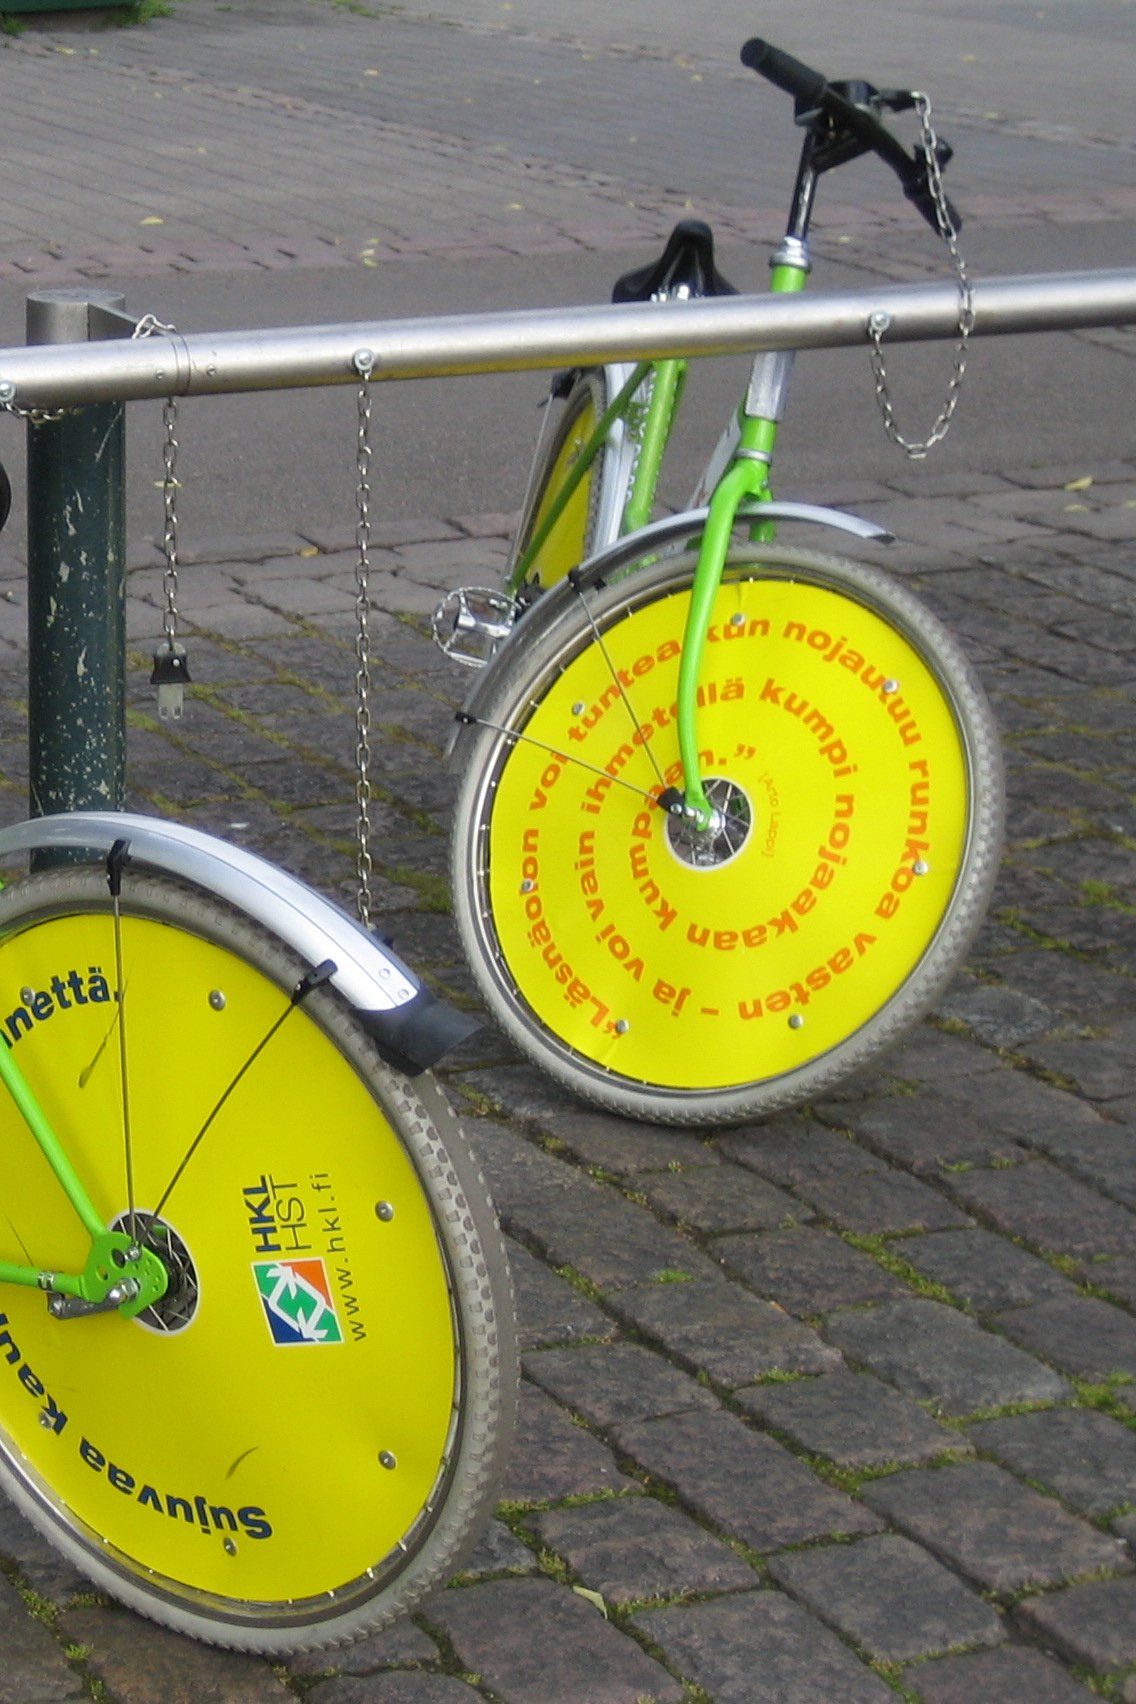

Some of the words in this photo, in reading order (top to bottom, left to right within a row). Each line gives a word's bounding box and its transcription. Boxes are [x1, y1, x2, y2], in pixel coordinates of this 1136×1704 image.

[568, 639, 681, 744] tuntea
[760, 678, 859, 779] kumpi
[574, 830, 605, 922] vain
[686, 793, 855, 952] nojaakaan
[875, 759, 930, 921] runkoa
[596, 923, 645, 983] voi
[652, 979, 692, 1018] ja
[738, 932, 877, 1020] vasten
[242, 1174, 282, 1253] HKL
[268, 1173, 312, 1251] HST
[309, 1173, 367, 1342] www.hkl.fi
[78, 1435, 273, 1540] Sujuvaa
